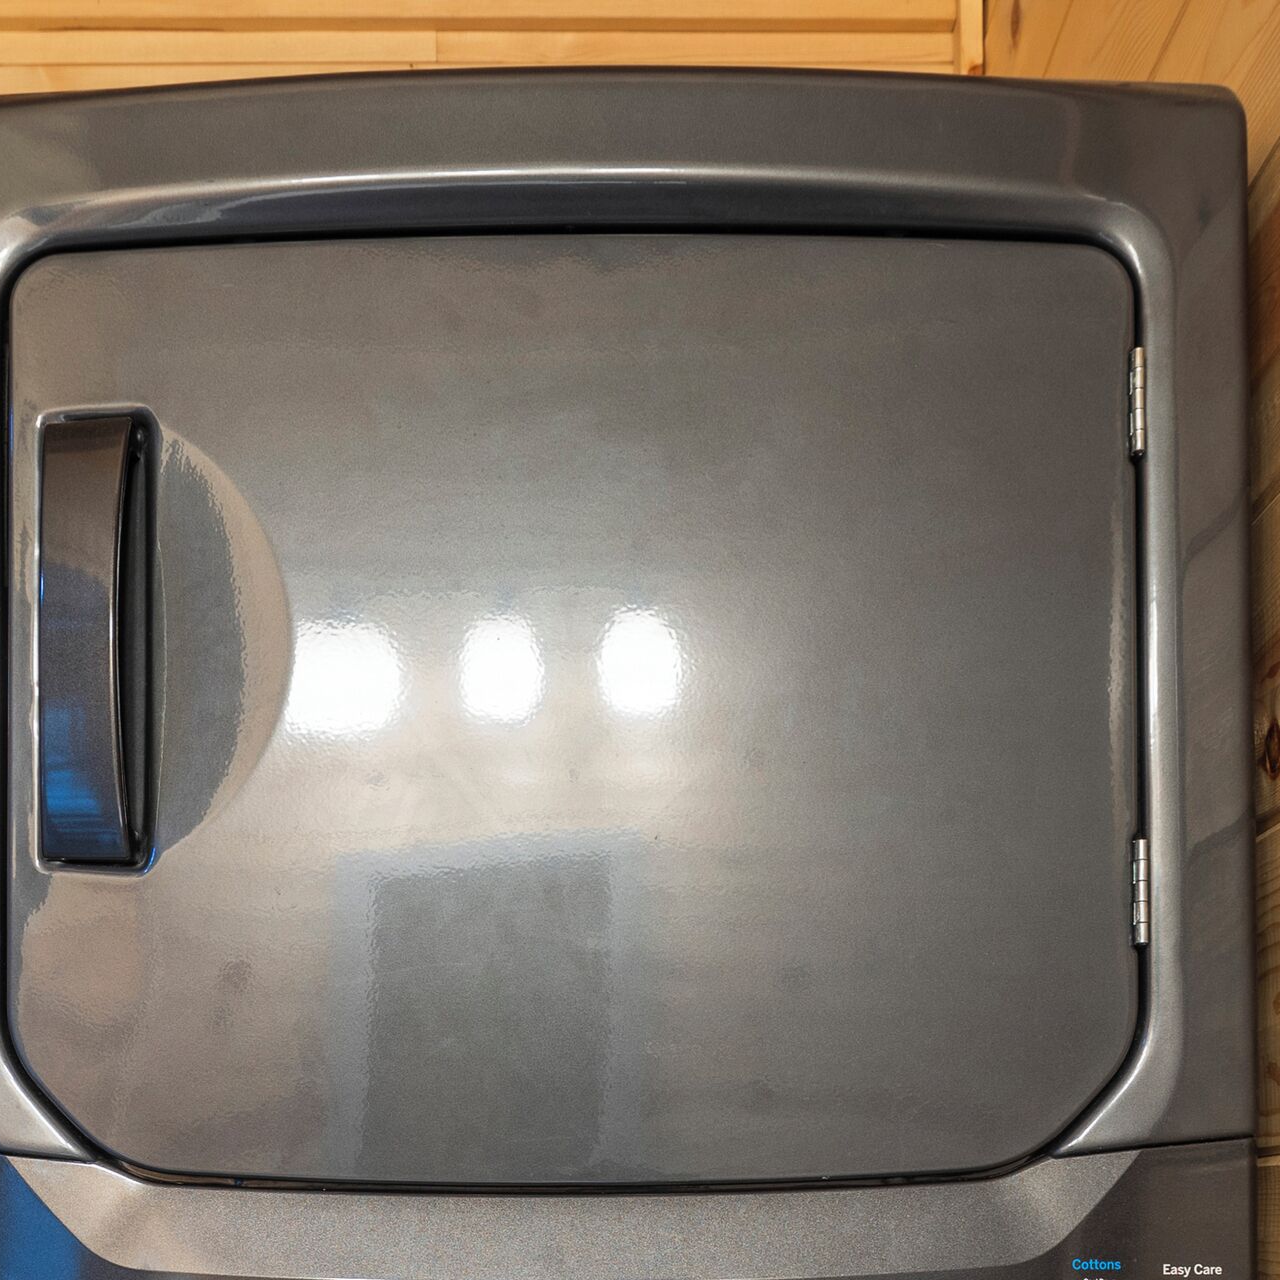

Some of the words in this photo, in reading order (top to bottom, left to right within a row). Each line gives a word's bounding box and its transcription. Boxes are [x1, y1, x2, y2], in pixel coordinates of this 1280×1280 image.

[1072, 1258, 1121, 1271] Cottons
[1163, 1264, 1191, 1278] Easy
[1194, 1264, 1222, 1275] Care
